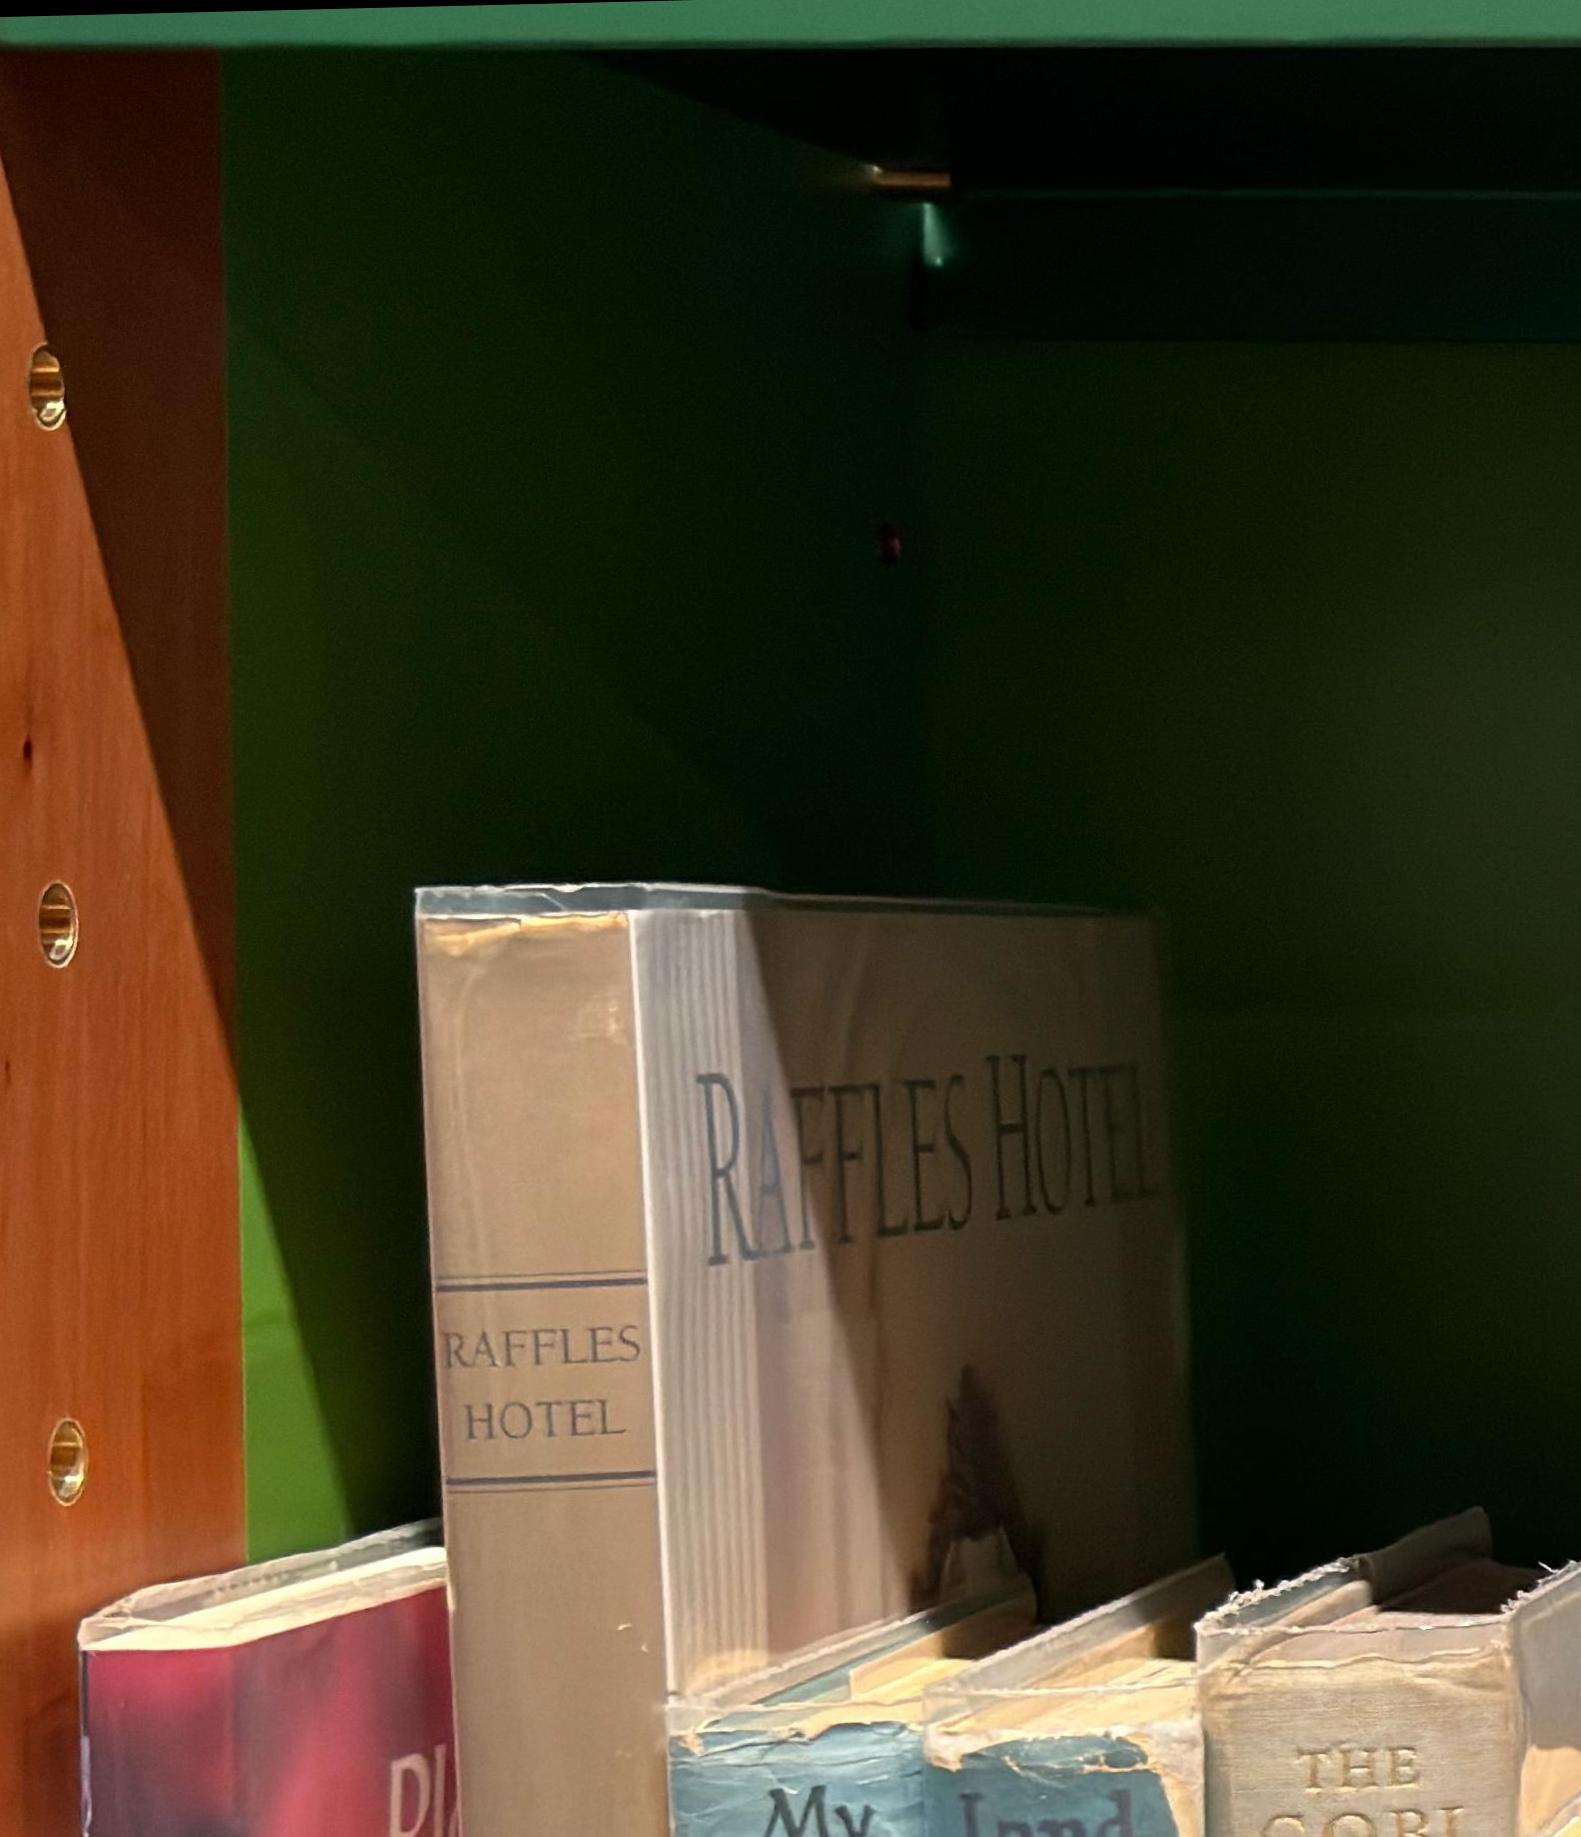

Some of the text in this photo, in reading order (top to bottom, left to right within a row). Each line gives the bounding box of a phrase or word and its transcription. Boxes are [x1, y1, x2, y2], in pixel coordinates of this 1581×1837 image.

[443, 1325, 640, 1368] RAFFLES
[465, 1398, 626, 1441] HOTEL
[1296, 1743, 1419, 1792] THE
